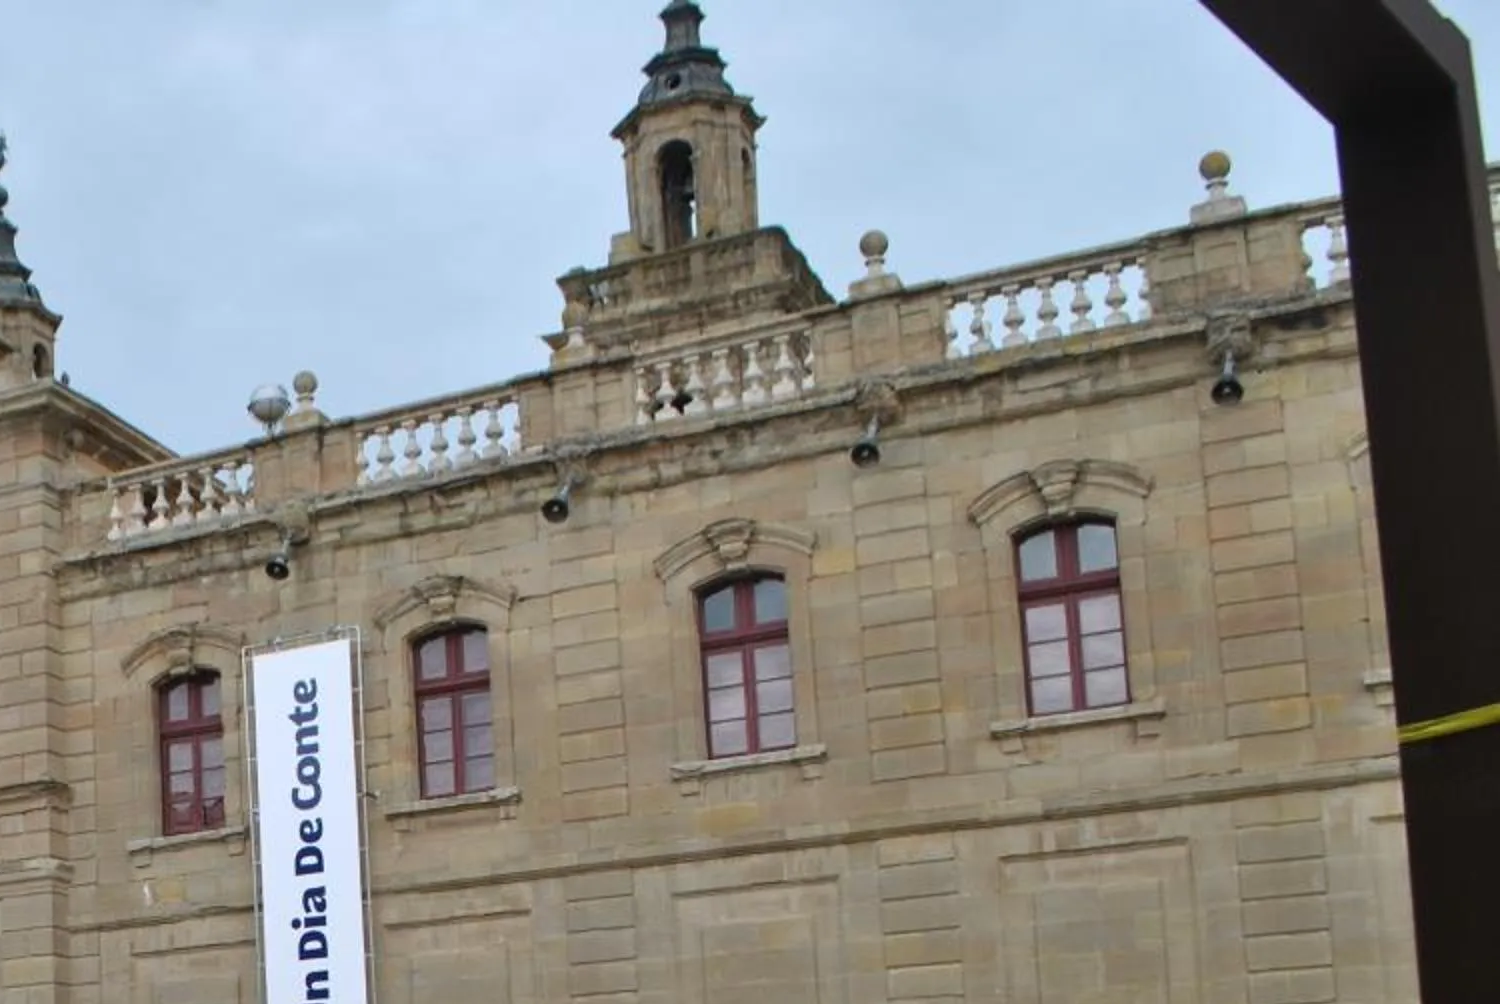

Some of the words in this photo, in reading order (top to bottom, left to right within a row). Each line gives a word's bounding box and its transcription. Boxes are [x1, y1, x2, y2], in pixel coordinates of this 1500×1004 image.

[289, 679, 322, 811] Conte
[294, 817, 325, 877] De
[291, 885, 329, 961] Dia
